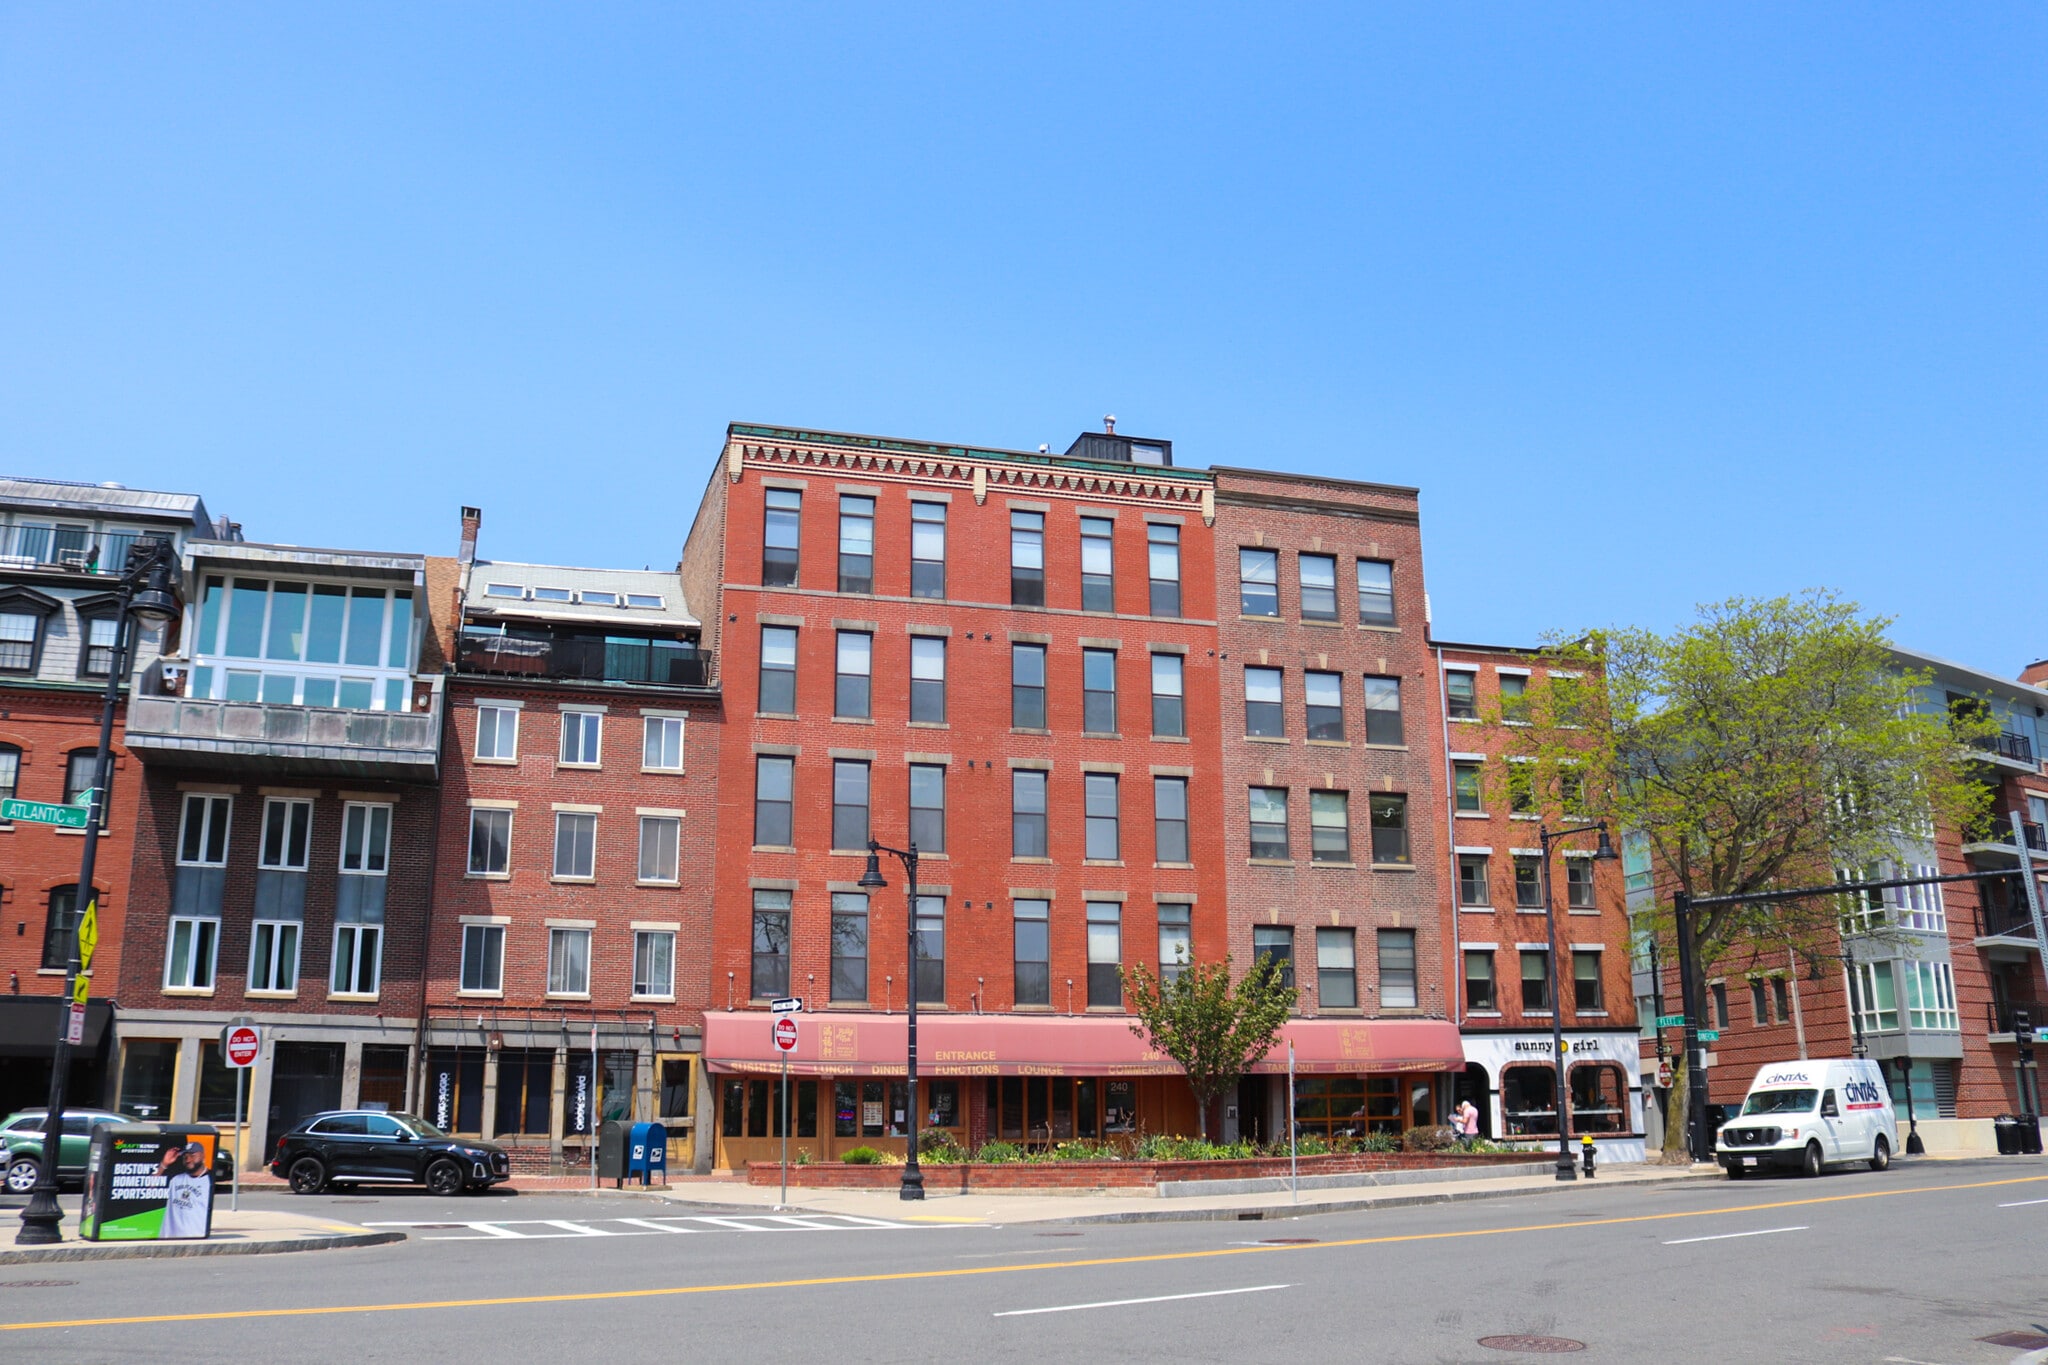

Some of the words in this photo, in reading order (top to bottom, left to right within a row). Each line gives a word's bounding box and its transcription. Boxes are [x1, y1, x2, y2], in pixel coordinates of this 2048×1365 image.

[8, 803, 66, 823] ATLANTIC
[1515, 1041, 1553, 1053] sunny
[1573, 1040, 1599, 1053] girl
[935, 1051, 996, 1061] ENTRANCE
[1142, 1052, 1160, 1061] 240
[730, 1062, 766, 1072] SUSHI
[814, 1065, 853, 1075] LUNCH
[872, 1065, 909, 1075] DINNE
[935, 1065, 999, 1075] FUNCTIONS
[1017, 1065, 1064, 1075] LOUNGE
[1108, 1065, 1179, 1075] COMMERCIAL
[1335, 1063, 1382, 1073] DELIVERY
[1399, 1062, 1447, 1071] CATERING
[1766, 1072, 1808, 1084] CINTAS
[1110, 1082, 1128, 1092] 240
[1846, 1076, 1879, 1102] CINTAS
[114, 1163, 159, 1174] BOSTON'S
[112, 1176, 168, 1187] HOMETOWN
[111, 1188, 170, 1200] SPORTSBOOK
